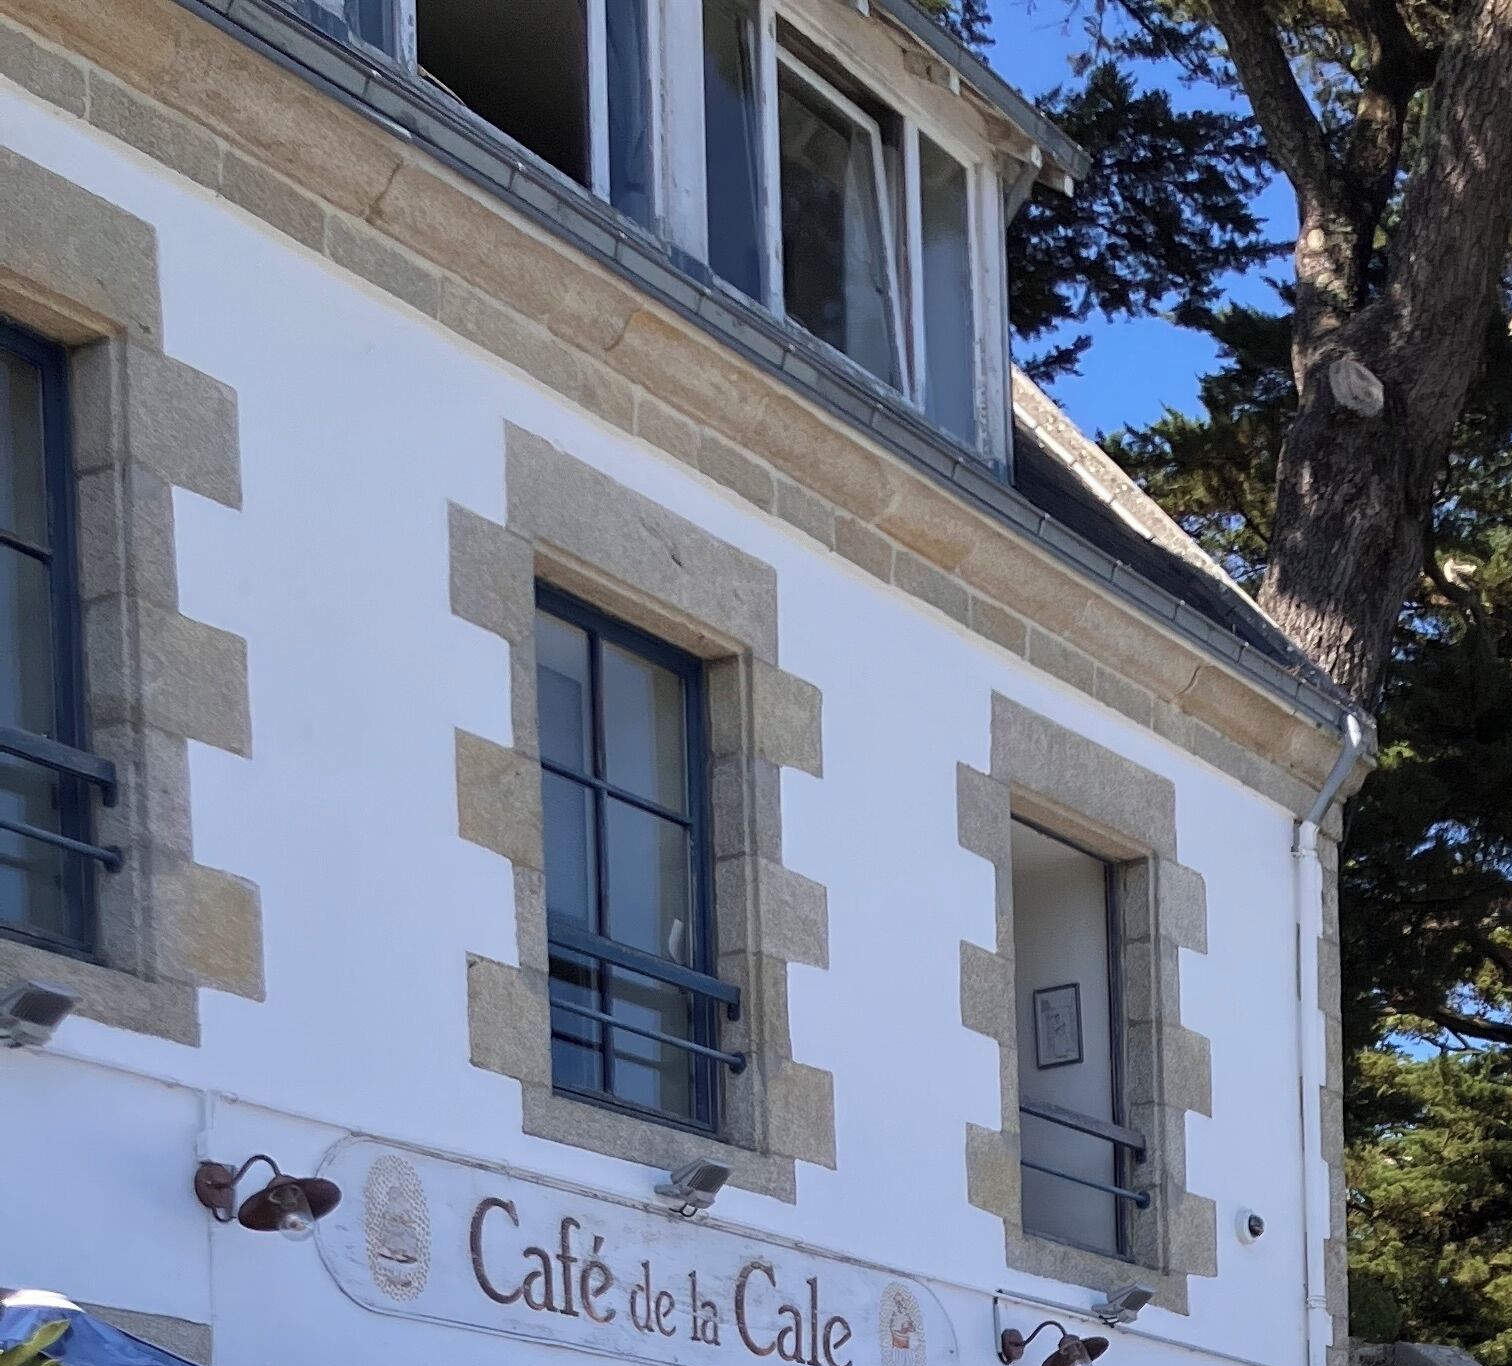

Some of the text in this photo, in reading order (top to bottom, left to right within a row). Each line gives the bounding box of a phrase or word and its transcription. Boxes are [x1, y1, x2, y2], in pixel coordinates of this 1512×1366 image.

[468, 1197, 616, 1324] Café
[631, 1260, 676, 1335] de
[690, 1270, 720, 1346] la
